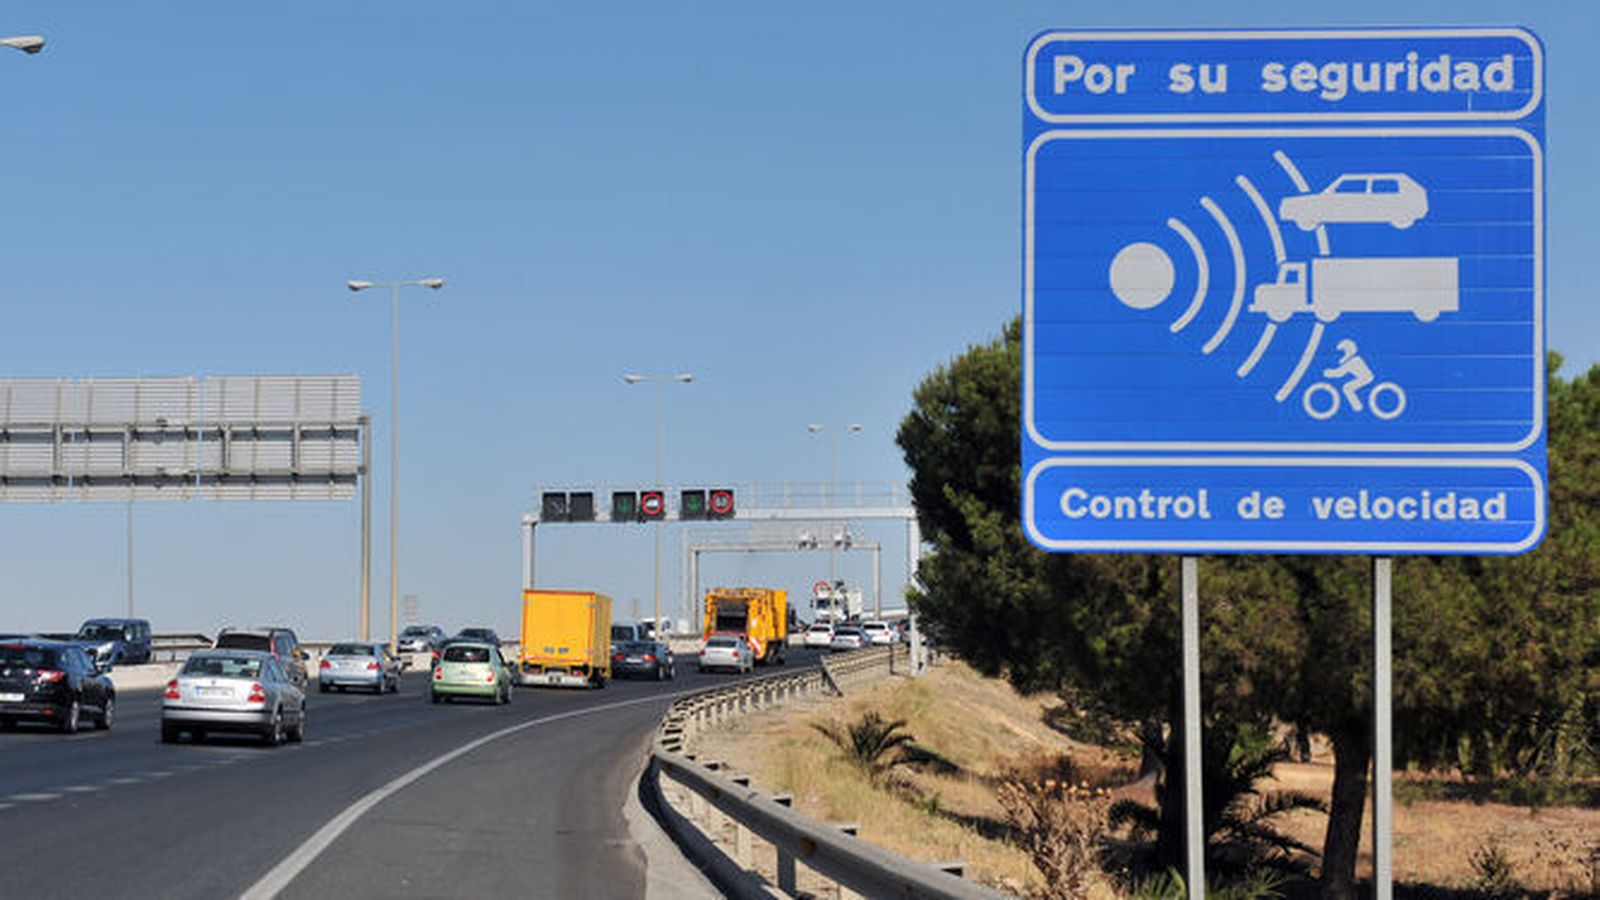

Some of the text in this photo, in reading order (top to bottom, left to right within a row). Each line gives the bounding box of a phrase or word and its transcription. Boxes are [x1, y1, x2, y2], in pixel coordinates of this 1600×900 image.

[1054, 52, 1514, 101] Por su seguridad
[1060, 487, 1507, 520] Control de velocidad
